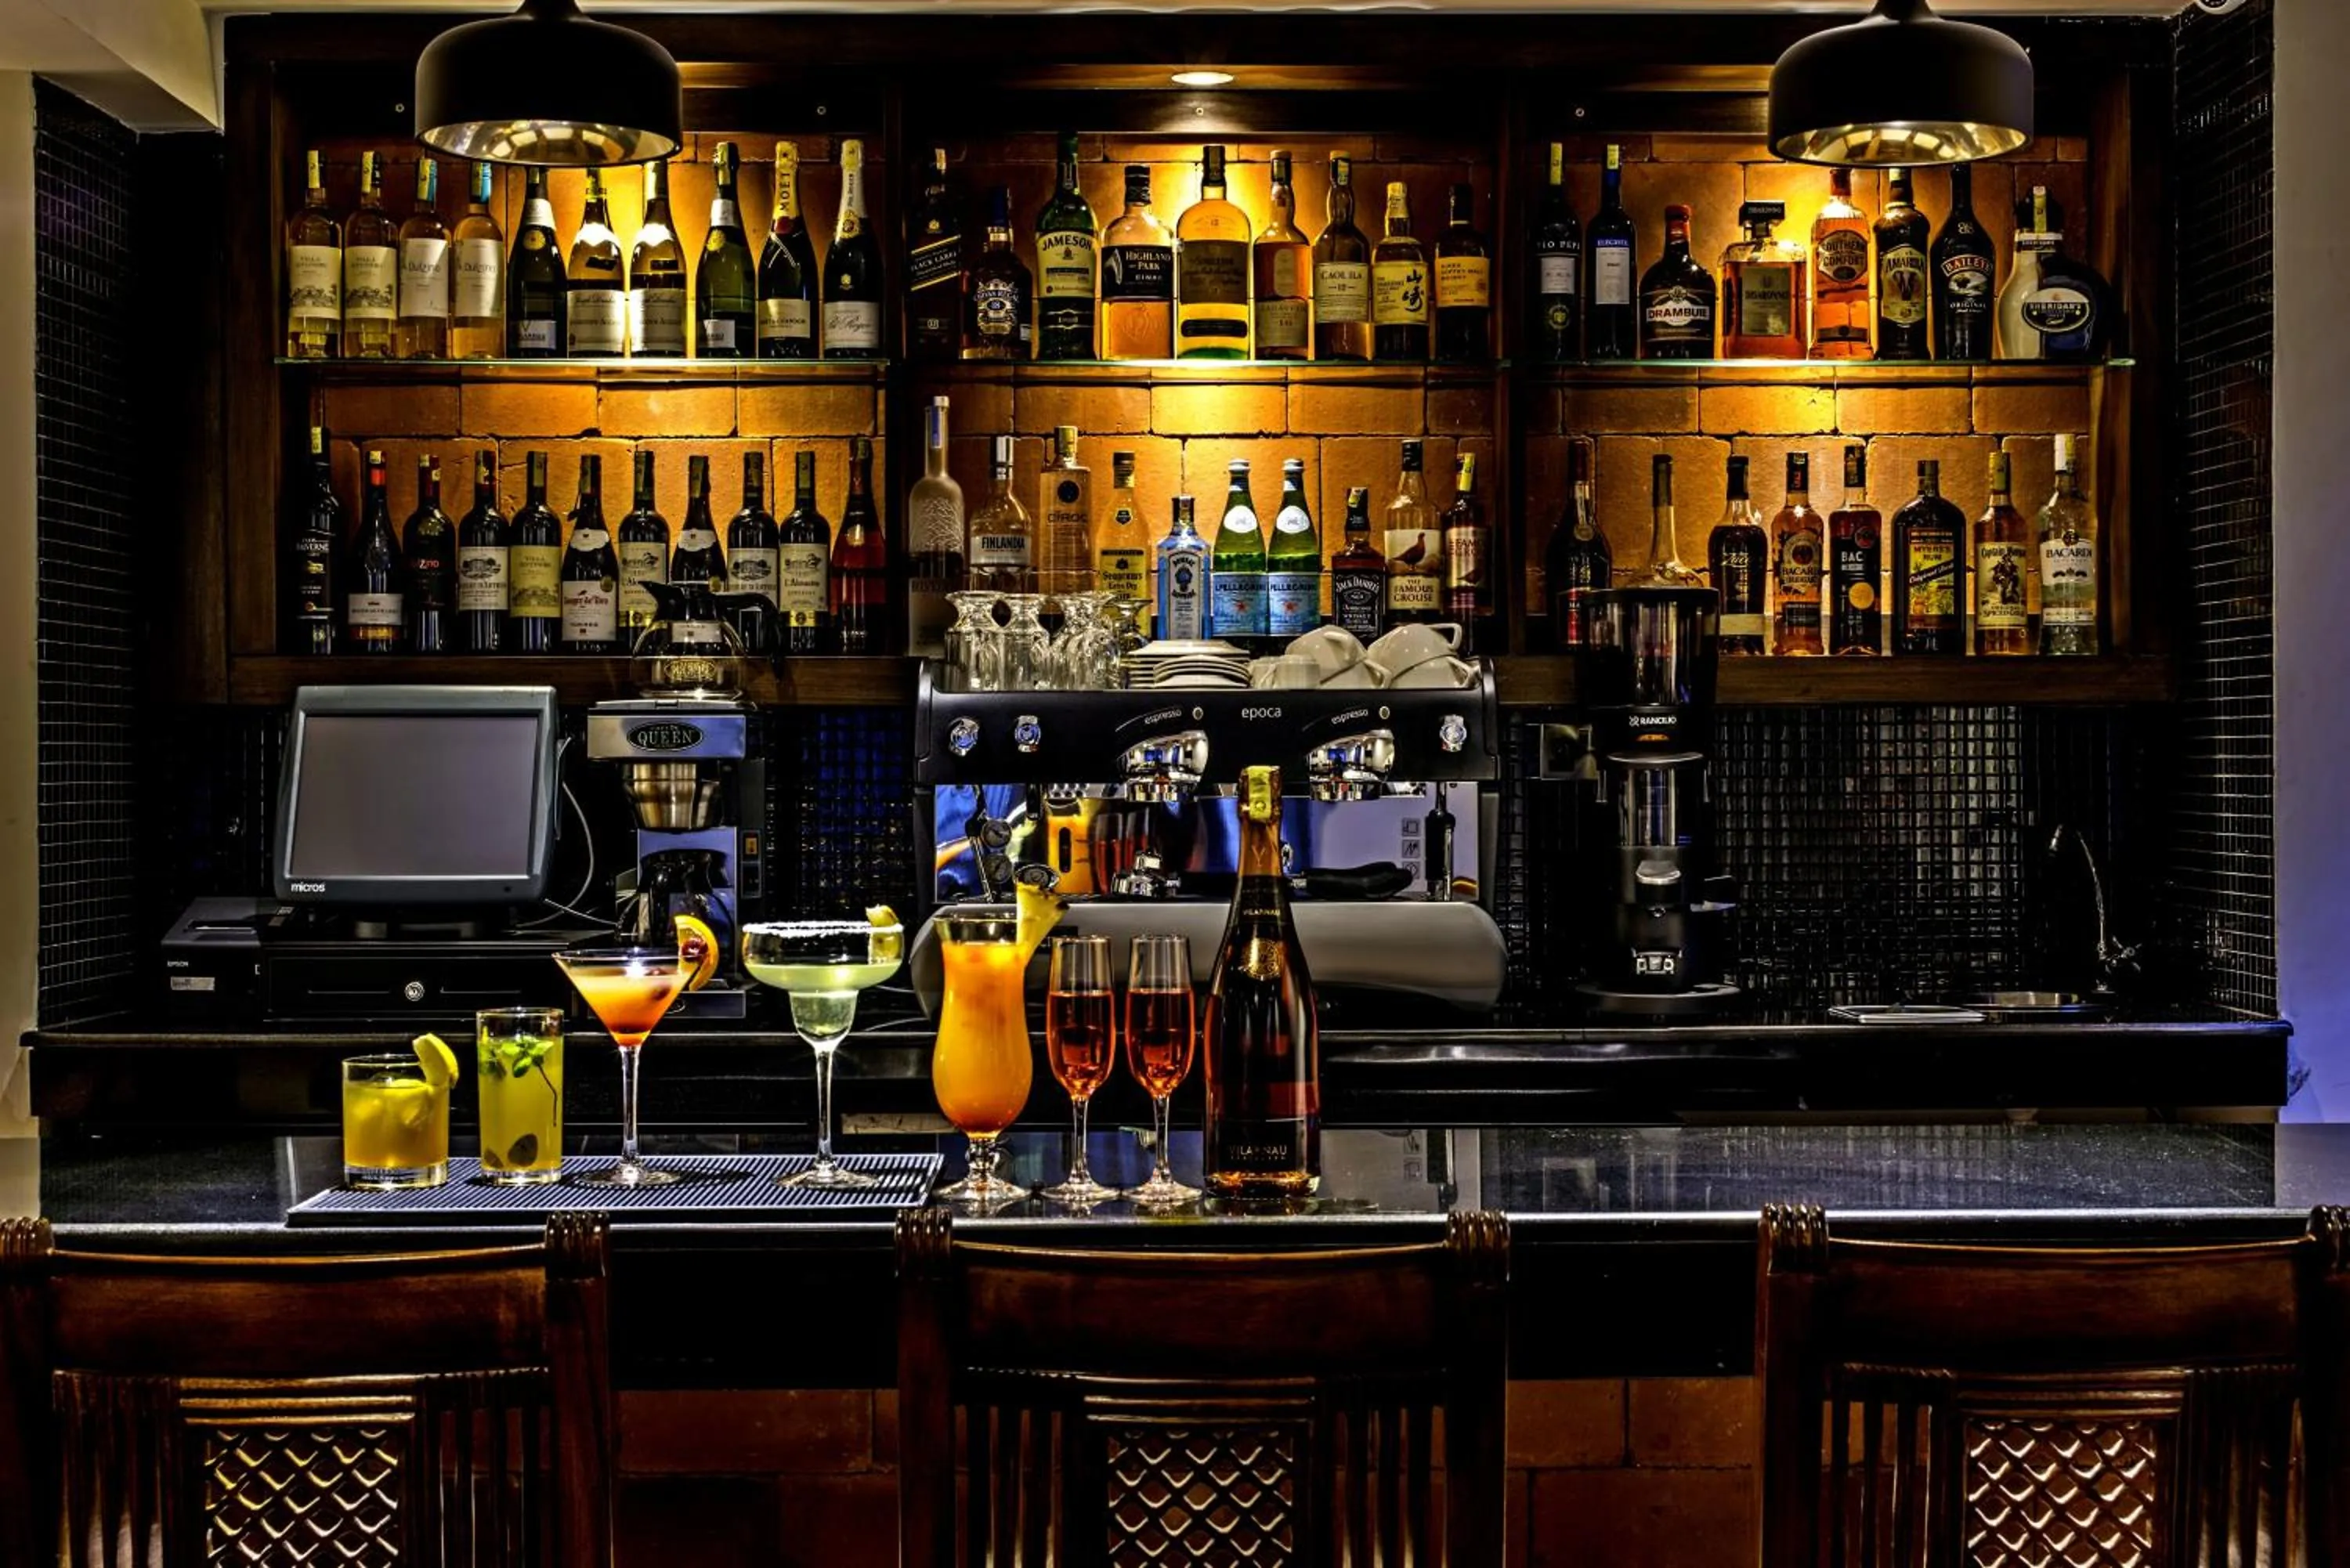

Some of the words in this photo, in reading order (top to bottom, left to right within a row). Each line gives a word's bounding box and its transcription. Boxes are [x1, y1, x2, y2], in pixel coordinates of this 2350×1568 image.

[1043, 234, 1092, 251] JAMESON
[1125, 250, 1171, 261] HIGHLAND
[1138, 262, 1160, 270] PARK
[1944, 256, 1991, 273] BAILEYS
[1647, 306, 1708, 319] DRAMBUIE
[981, 536, 1025, 549] FINLANDIA
[2045, 547, 2092, 558] BACARDI
[1394, 584, 1434, 594] FAMOUS
[1393, 593, 1433, 602] GROUSE
[1144, 708, 1182, 725] espresso
[1241, 707, 1282, 721] epoca
[1331, 709, 1368, 724] espresso
[1640, 716, 1677, 724] RANCILIO
[637, 730, 693, 746] QUEEN
[290, 882, 326, 892] micros
[1229, 1145, 1287, 1156] VILANAU
